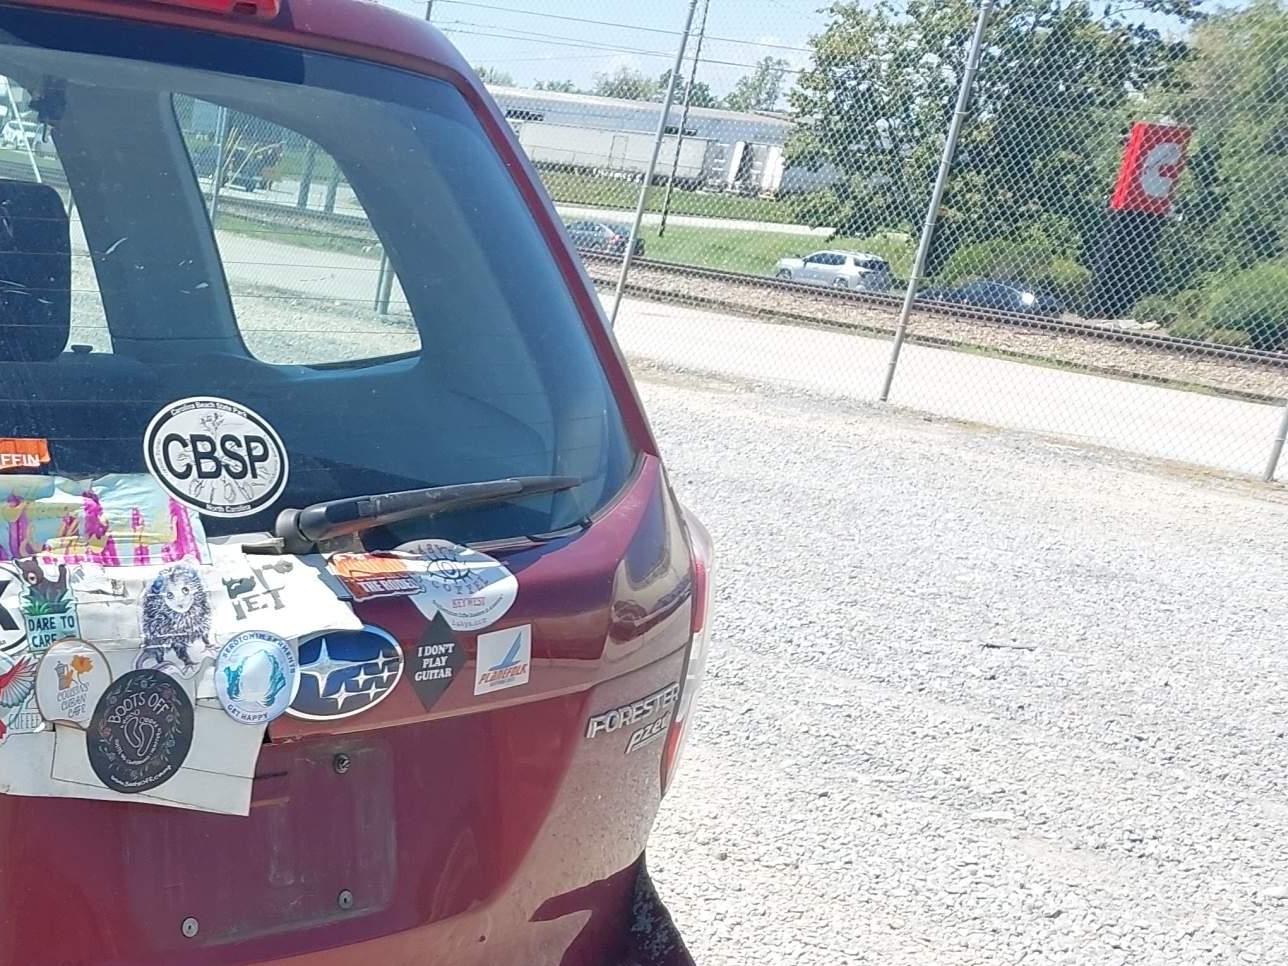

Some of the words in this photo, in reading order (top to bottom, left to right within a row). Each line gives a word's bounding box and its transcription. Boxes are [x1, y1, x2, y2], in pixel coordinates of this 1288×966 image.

[162, 432, 269, 480] CBSP
[28, 617, 57, 631] DARE
[60, 616, 75, 629] TO
[417, 647, 424, 657] I
[424, 643, 455, 657] DON'T
[422, 656, 449, 669] PLAY
[415, 668, 453, 682] GUITAR
[108, 691, 146, 724] BOOTS
[147, 692, 170, 715] OFF
[585, 681, 680, 739] FORESTER
